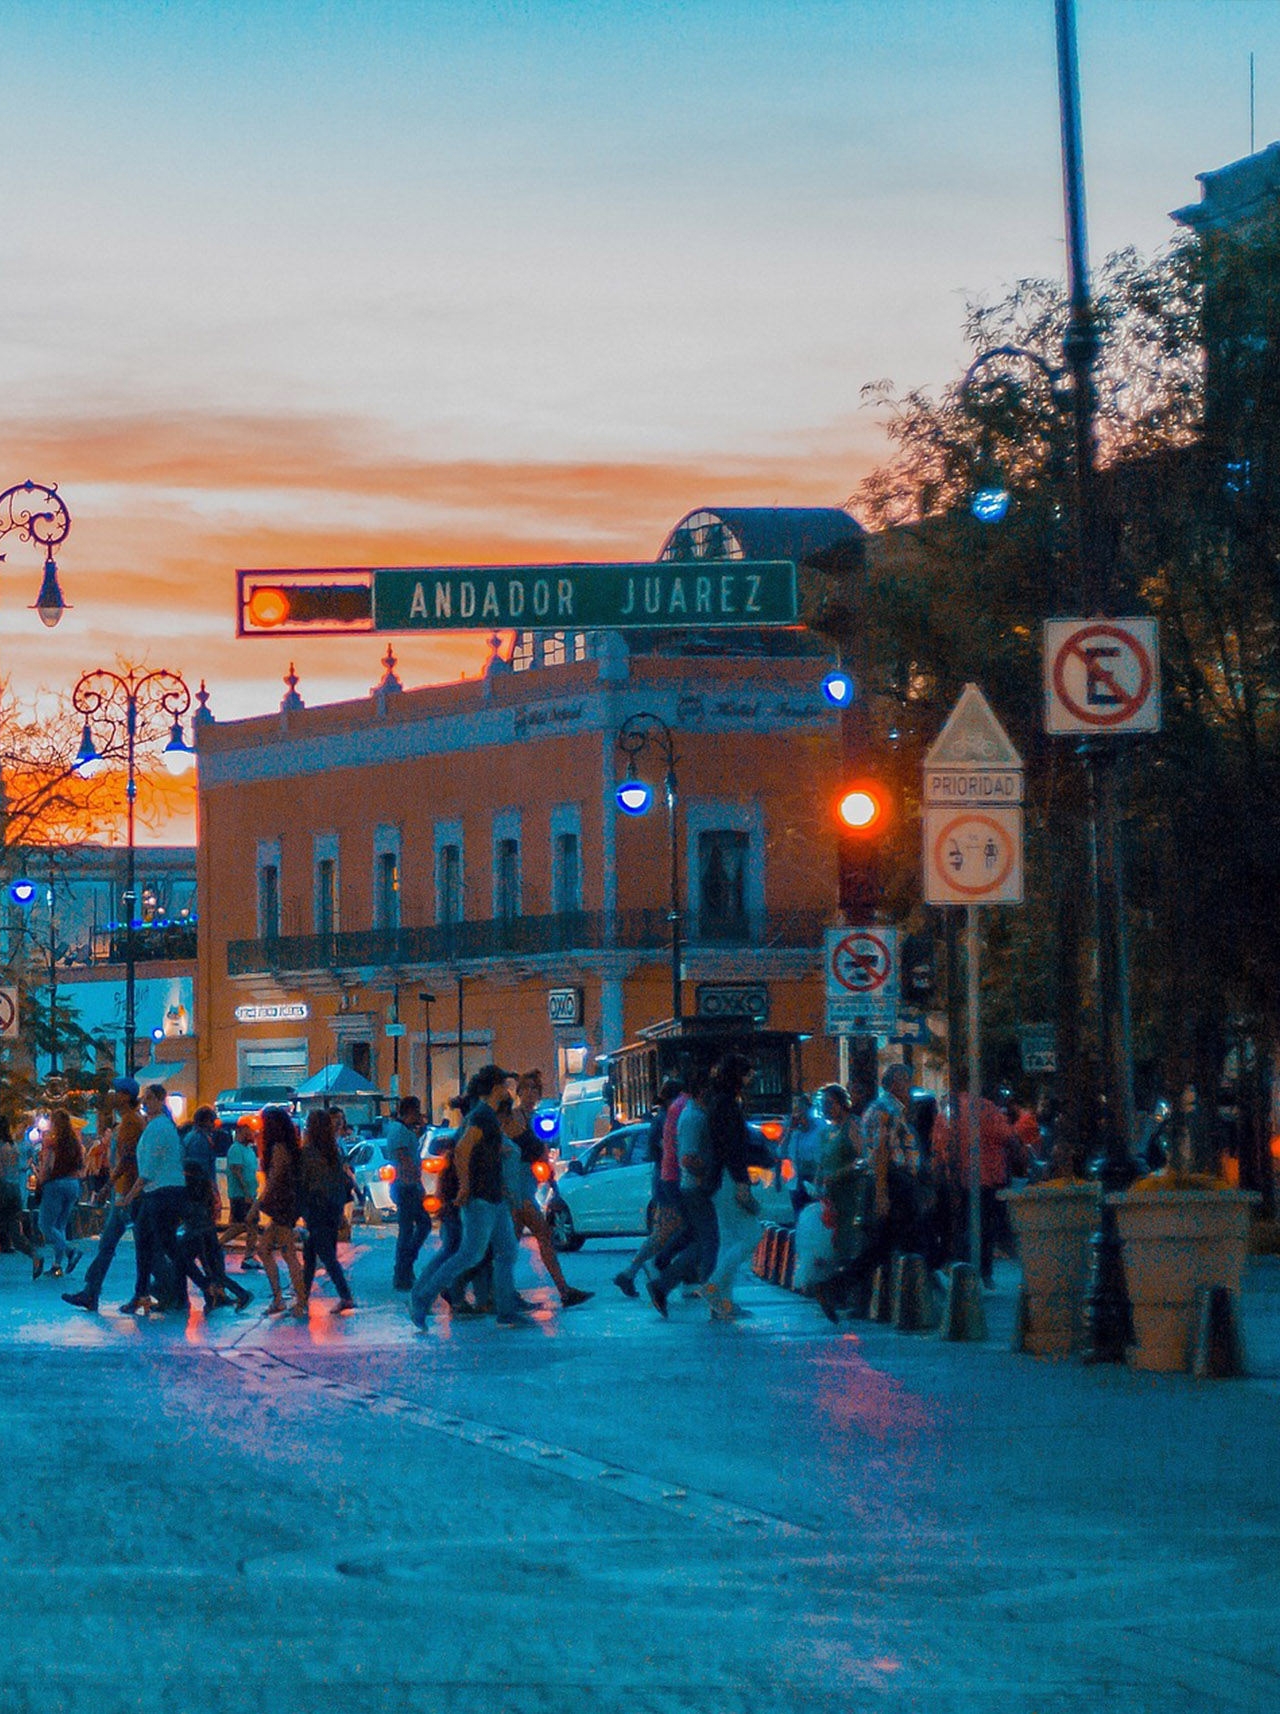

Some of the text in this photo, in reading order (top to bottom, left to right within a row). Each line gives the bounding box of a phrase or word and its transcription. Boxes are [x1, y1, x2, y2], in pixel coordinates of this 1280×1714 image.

[409, 574, 762, 619] ANDADOR JUAREZ
[1086, 646, 1125, 705] E
[932, 775, 1015, 796] PRIORIDAD
[549, 995, 575, 1017] OXXO
[703, 993, 765, 1014] OXXO
